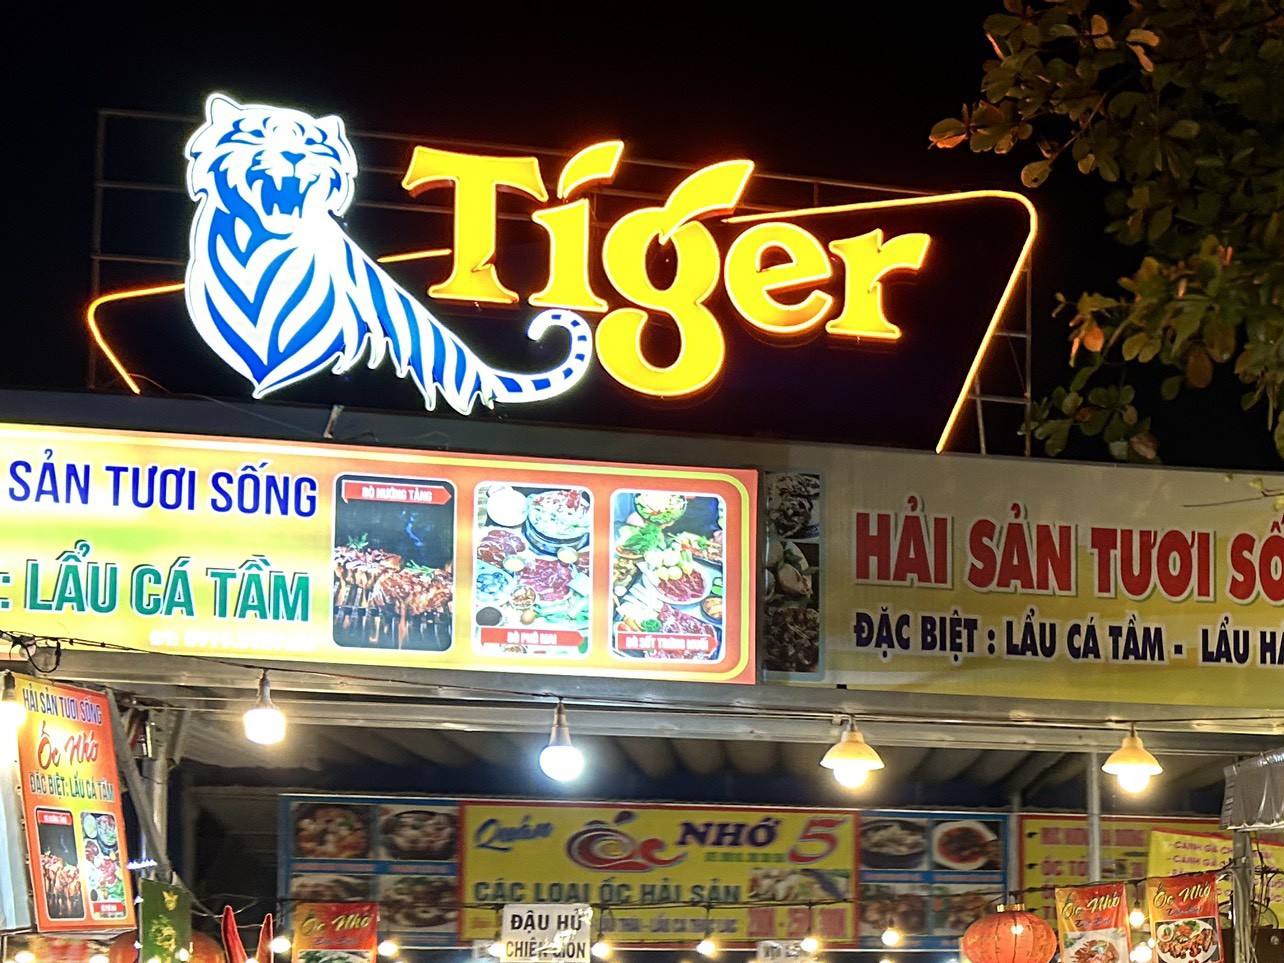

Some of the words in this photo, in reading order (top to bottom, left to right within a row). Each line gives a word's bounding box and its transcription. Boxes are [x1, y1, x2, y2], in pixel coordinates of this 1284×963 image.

[402, 140, 930, 397] Tiger
[9, 449, 90, 505] SẢN
[105, 465, 196, 511] TƯƠI
[210, 462, 317, 518] SỐNG
[856, 495, 948, 584] HẢI
[967, 503, 1072, 591] SẢN
[1091, 527, 1211, 597] TƯƠI
[24, 540, 118, 614] LẨU
[131, 556, 195, 617] CÁ
[206, 554, 309, 622] TẦM
[854, 606, 911, 659] ĐẶC
[921, 609, 978, 662] BIỆT
[1006, 608, 1057, 659] LẨU
[1067, 616, 1101, 660] CÁ
[1108, 614, 1165, 662] TẦM
[1201, 616, 1249, 665] LẨU
[22, 683, 39, 713] HẢI
[40, 687, 58, 716] SẢN
[59, 696, 79, 720] TƯƠI
[80, 696, 103, 725] SỐNG
[38, 720, 62, 769] Ốc
[29, 769, 46, 797] ĐẶC
[85, 777, 98, 800] CÁ
[474, 814, 553, 852] Quán
[787, 818, 848, 866] 5
[473, 877, 525, 903] CÁC
[600, 876, 633, 903] ỐC
[640, 876, 683, 903] HẢI
[692, 876, 742, 903] SẢN
[511, 905, 550, 934] ĐẬU
